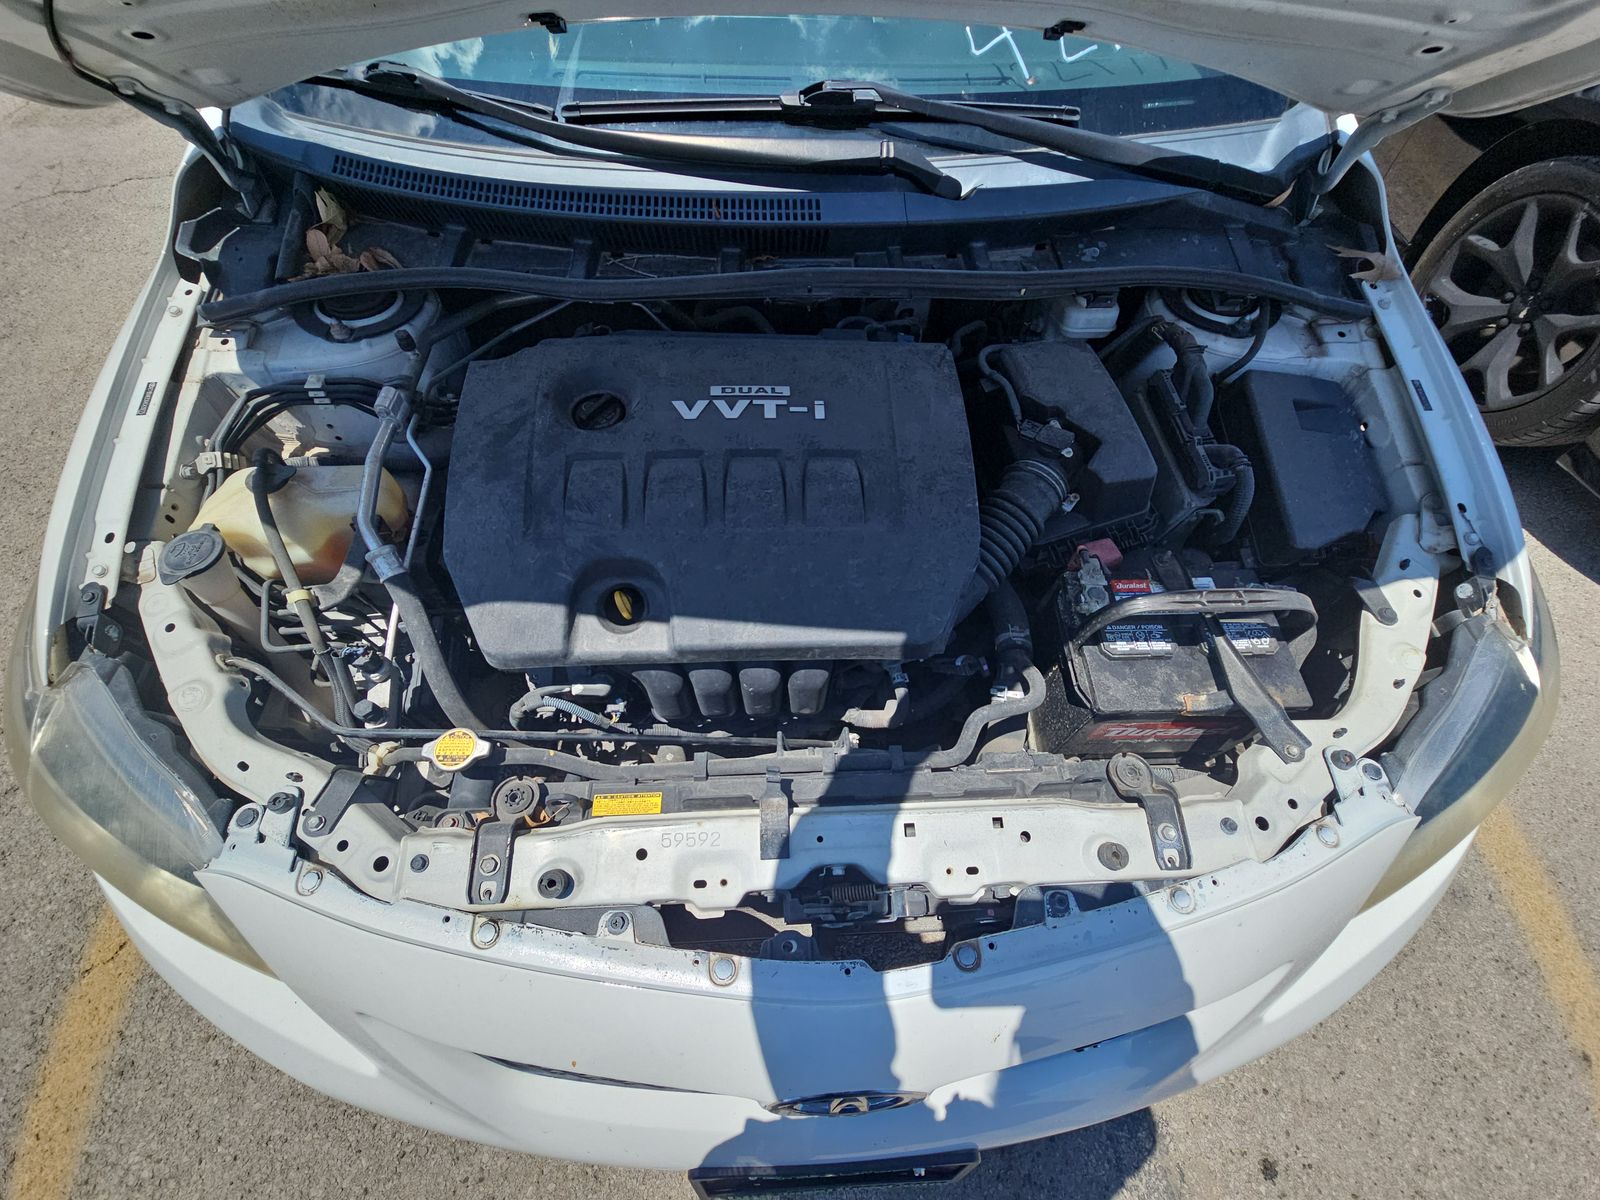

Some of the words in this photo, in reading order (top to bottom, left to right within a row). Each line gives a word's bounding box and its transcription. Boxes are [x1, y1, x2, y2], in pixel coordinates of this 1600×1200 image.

[720, 386, 784, 394] DUAL
[671, 399, 826, 420] VVT-i
[660, 831, 721, 849] 59592
